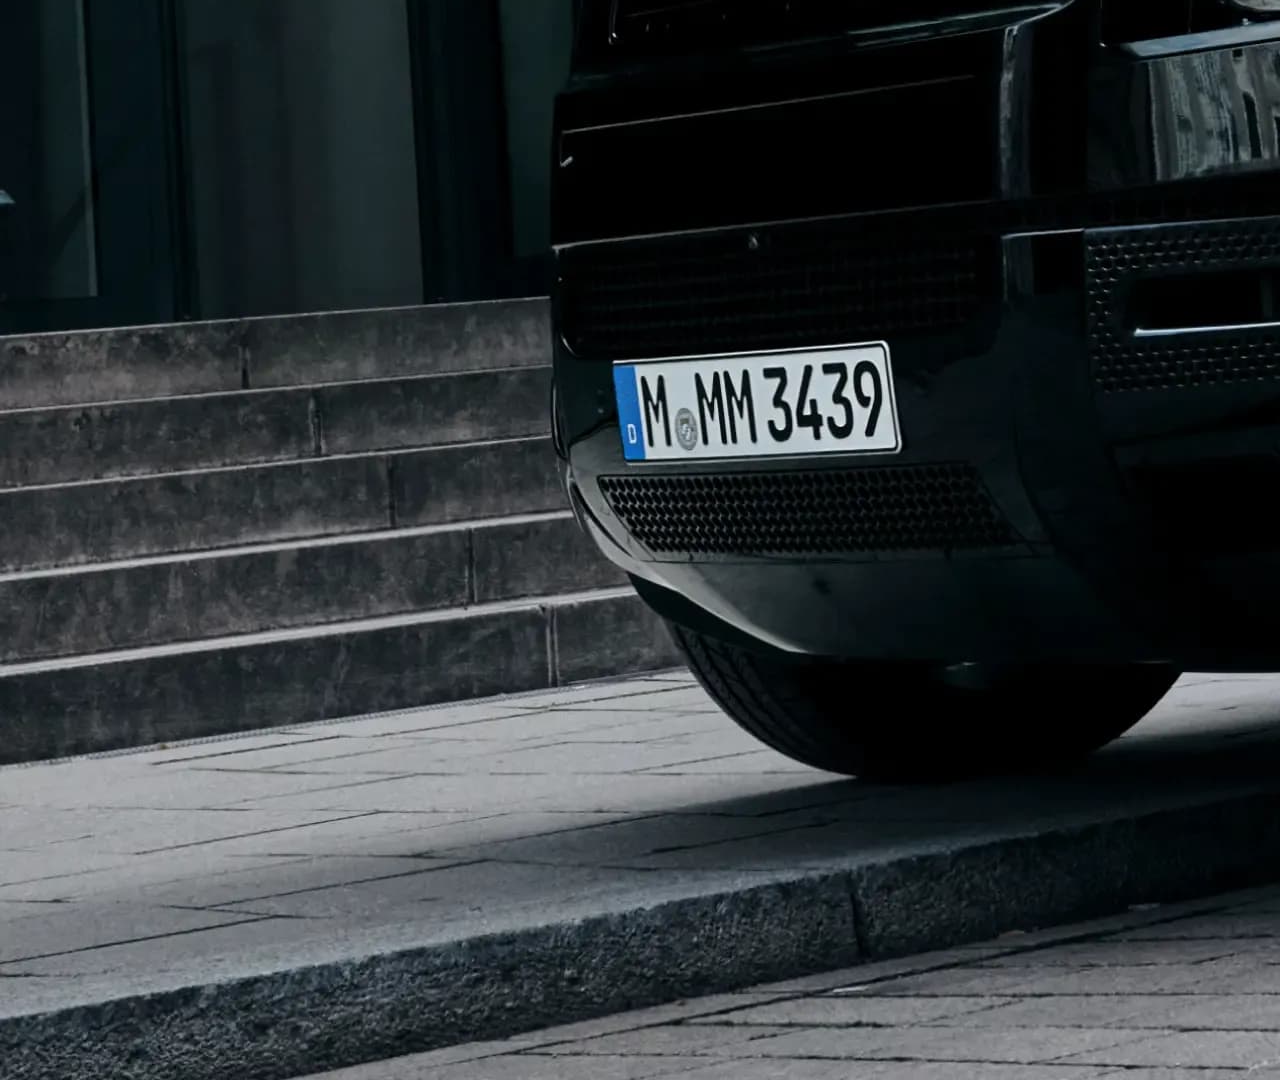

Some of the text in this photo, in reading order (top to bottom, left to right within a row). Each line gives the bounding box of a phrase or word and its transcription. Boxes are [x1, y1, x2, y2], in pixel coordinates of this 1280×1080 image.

[641, 374, 672, 448] M
[694, 369, 757, 445] MM
[763, 360, 883, 443] 3439
